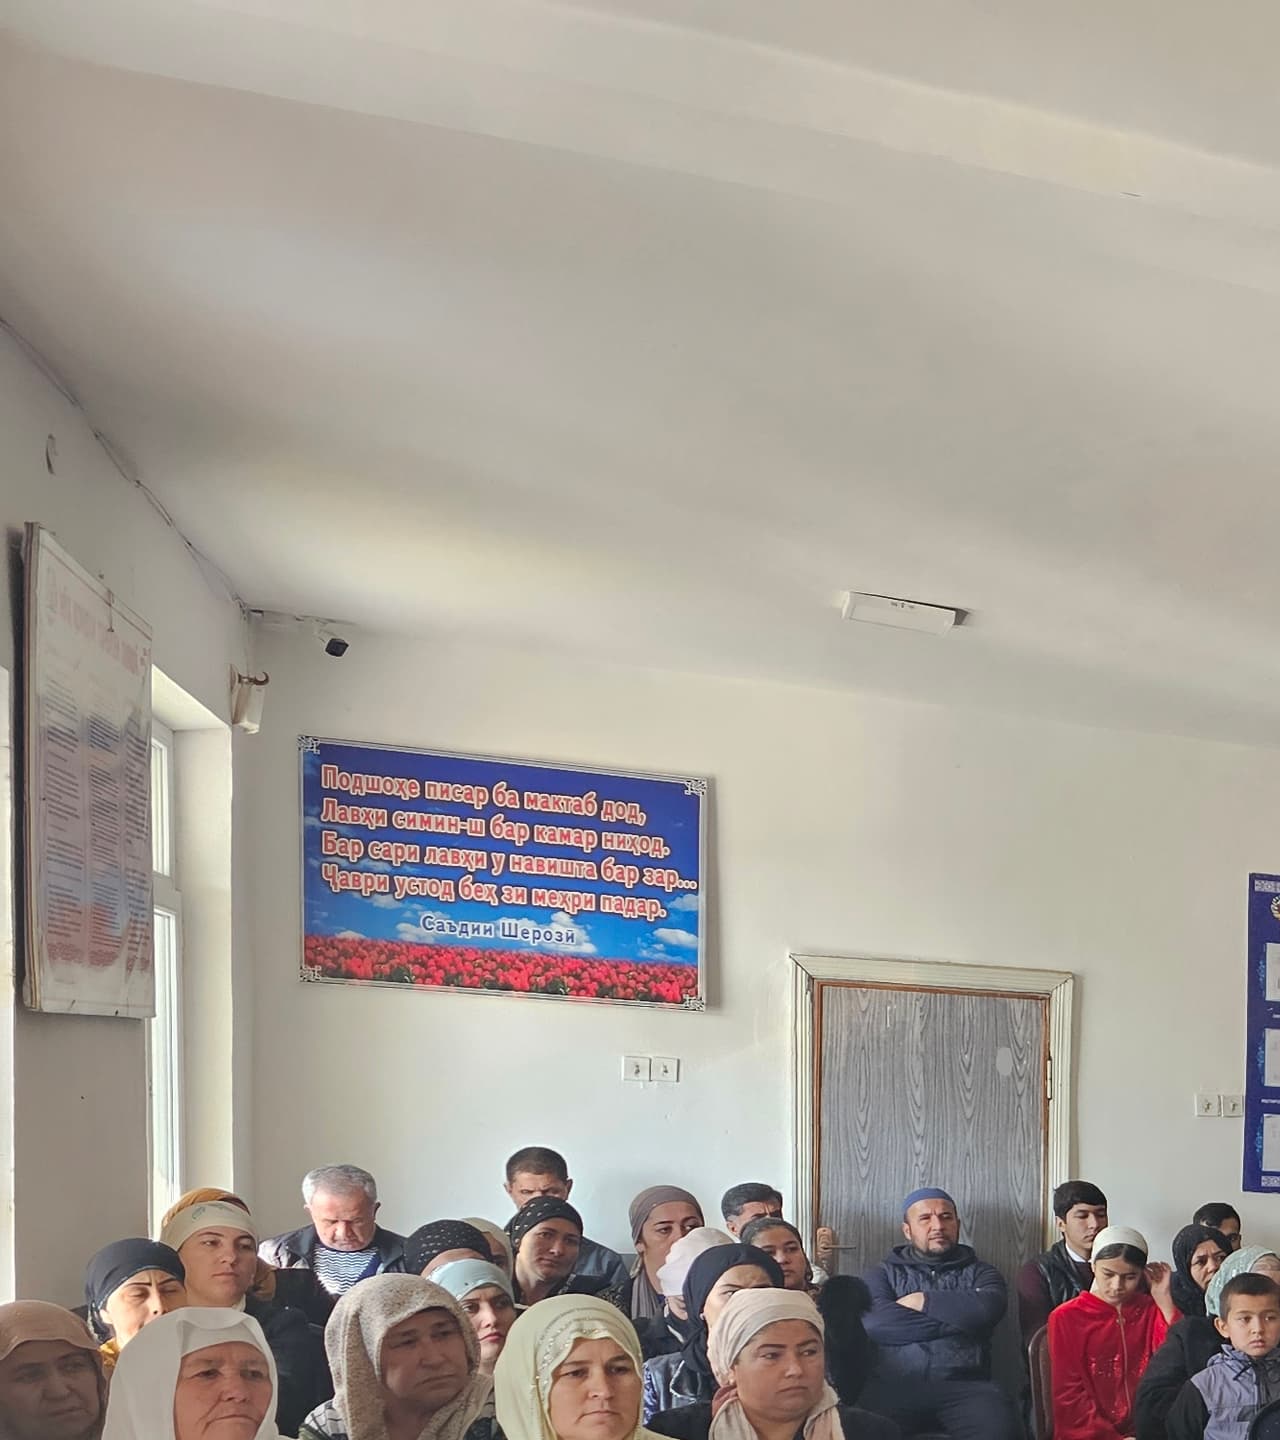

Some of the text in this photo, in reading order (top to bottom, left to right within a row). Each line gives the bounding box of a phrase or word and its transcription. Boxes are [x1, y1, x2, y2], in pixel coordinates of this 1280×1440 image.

[321, 764, 647, 826] Подшоҳе писар ба мактаб дод,
[320, 797, 671, 859] Лавҳи симин-ш бар камар ниҳод.
[322, 830, 364, 862] Бар
[367, 841, 420, 865] сари
[424, 846, 487, 871] лавҳи
[509, 854, 598, 880] навишта
[600, 856, 640, 889] бар
[322, 863, 667, 922] Ҷаври устод беҳ зи меҳри падар.
[420, 914, 493, 938] Саъдии
